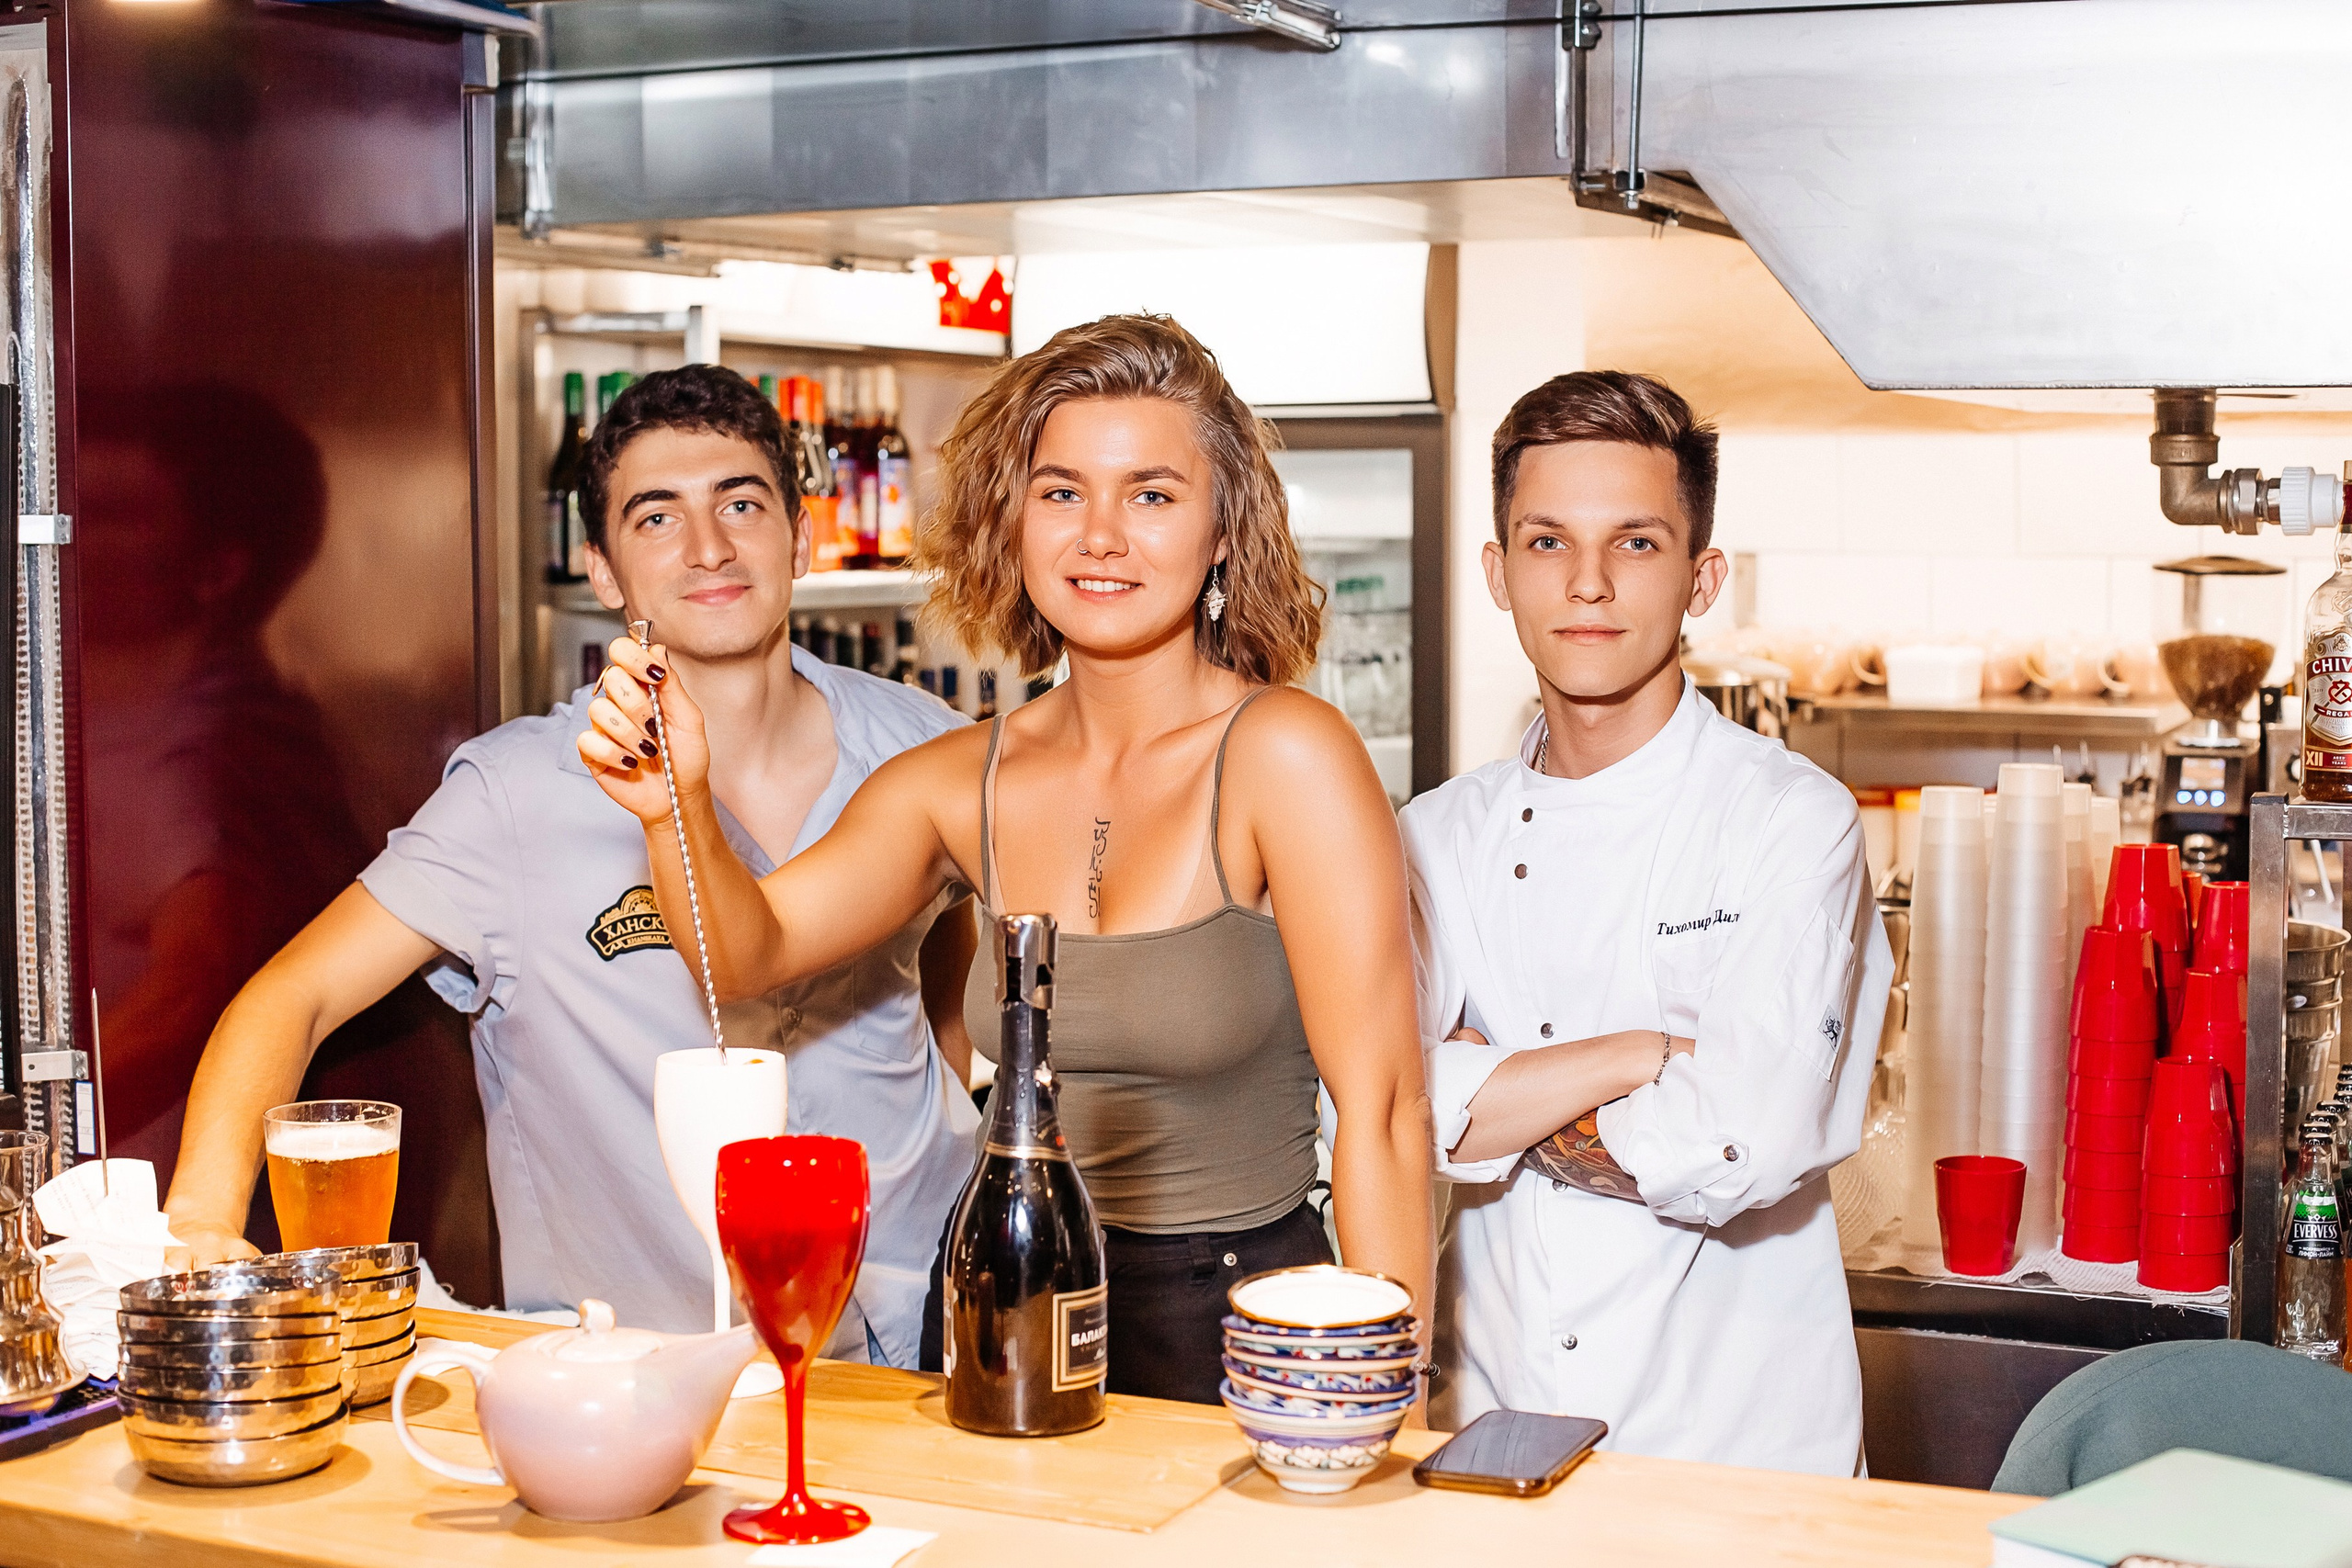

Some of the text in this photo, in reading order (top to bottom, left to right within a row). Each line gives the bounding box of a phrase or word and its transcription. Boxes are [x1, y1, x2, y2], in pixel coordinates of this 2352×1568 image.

[2312, 658, 2352, 674] CHIV
[2306, 750, 2324, 767] XII
[1657, 917, 1712, 935] Тихомир
[2294, 1223, 2337, 1239] EVERVESS
